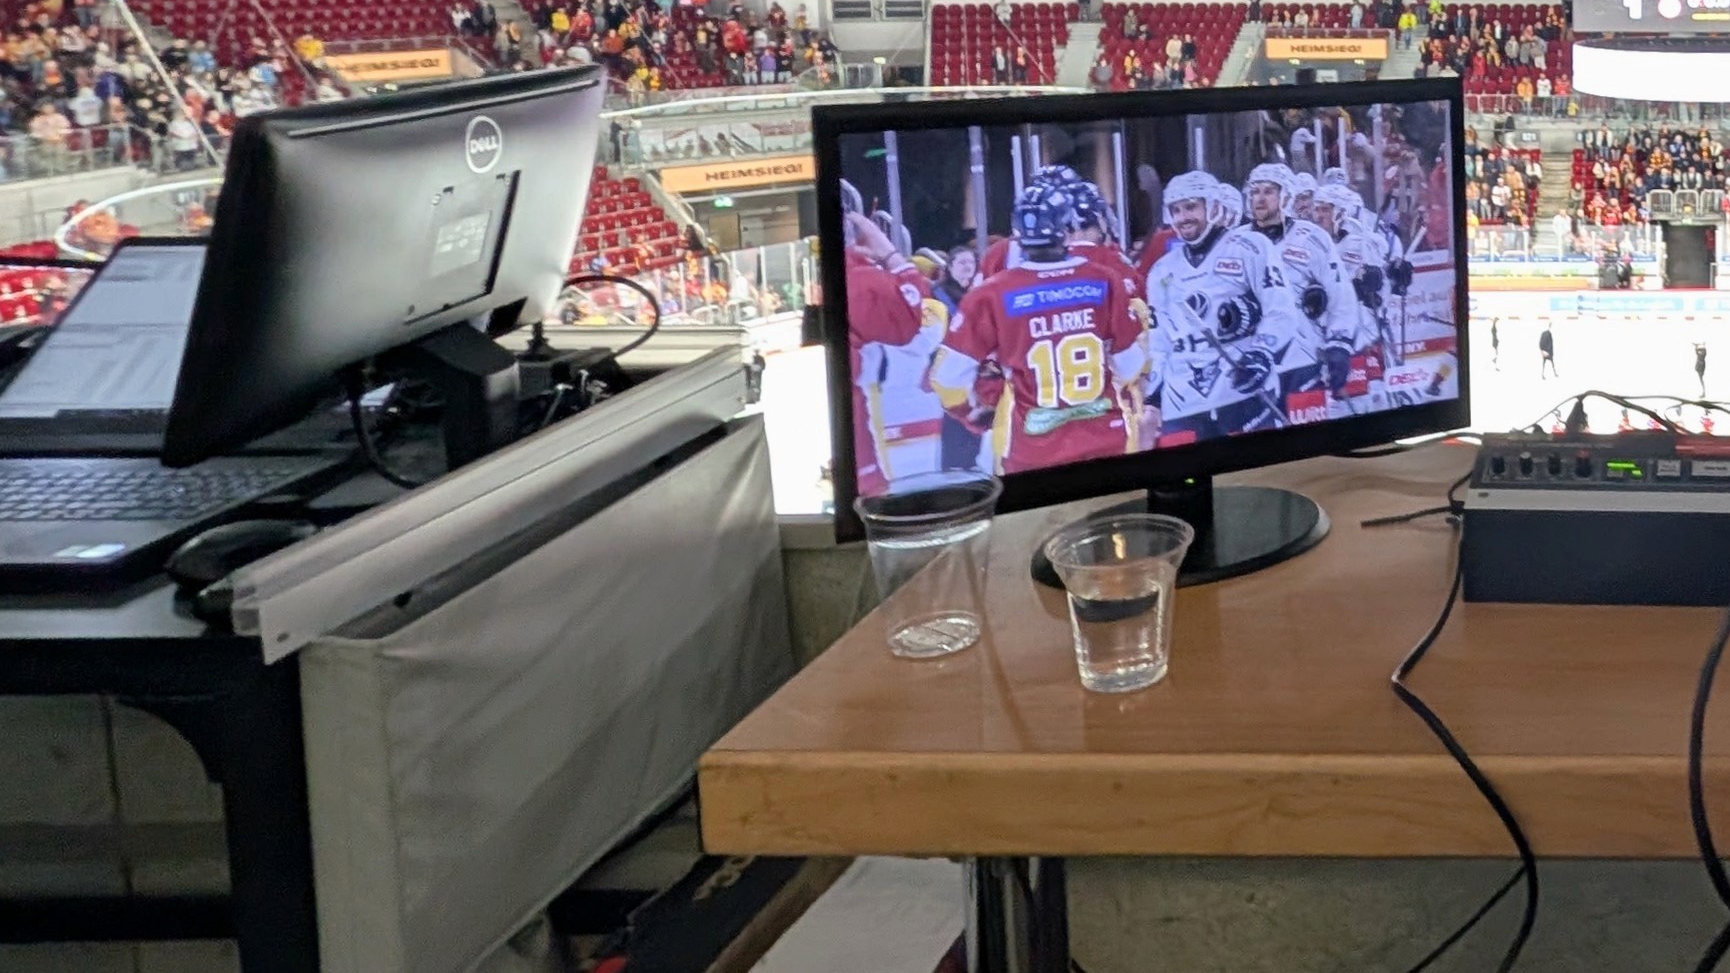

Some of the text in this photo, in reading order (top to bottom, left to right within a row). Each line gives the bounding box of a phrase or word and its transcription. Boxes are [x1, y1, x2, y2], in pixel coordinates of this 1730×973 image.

[1291, 44, 1361, 53] HEIMSIEG!
[470, 136, 499, 155] DELL
[705, 163, 803, 182] HEIMSIEG!
[1029, 308, 1096, 338] CLARKE
[1026, 331, 1105, 409] 18
